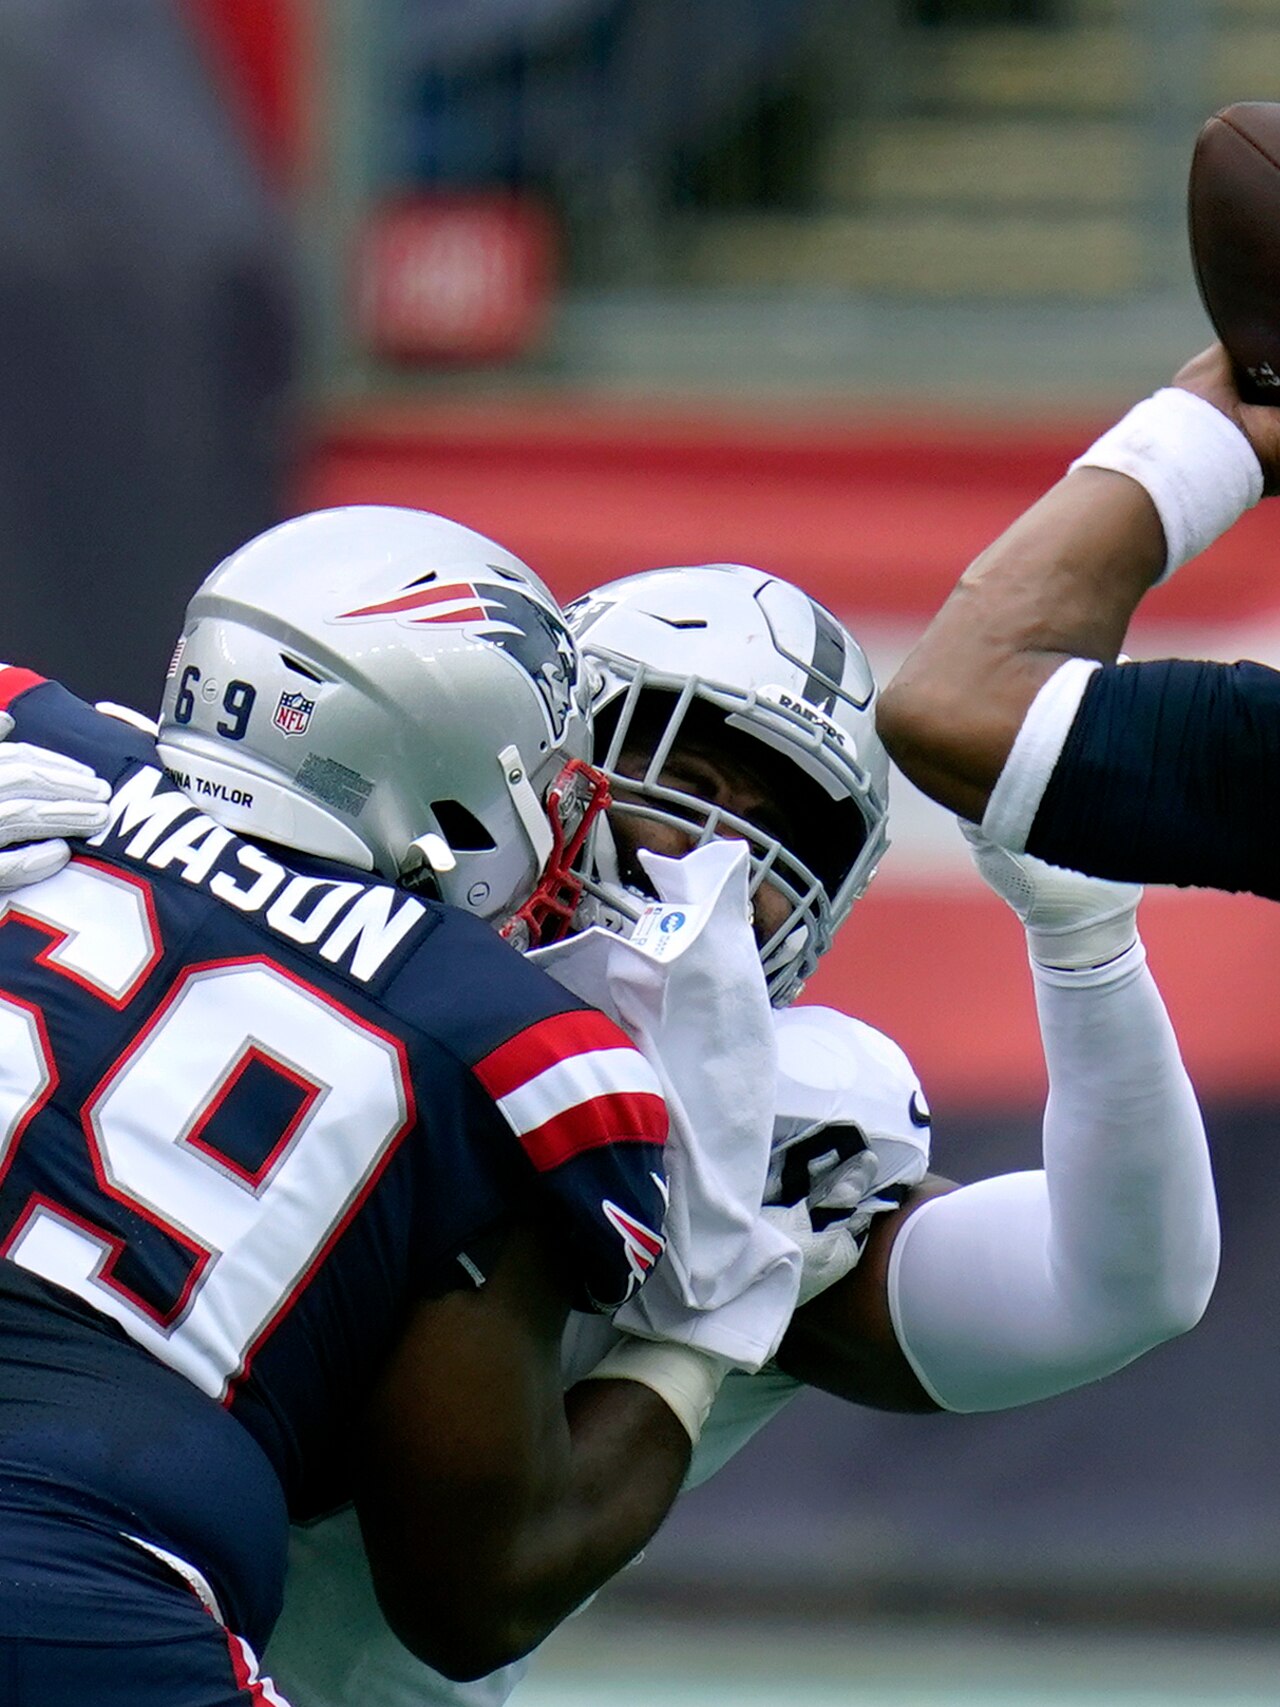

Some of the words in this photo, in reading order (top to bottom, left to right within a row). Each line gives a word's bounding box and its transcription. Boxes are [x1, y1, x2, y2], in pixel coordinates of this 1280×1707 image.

[276, 706, 306, 731] NFL
[196, 777, 254, 809] TAYLOR
[88, 765, 427, 981] MASON
